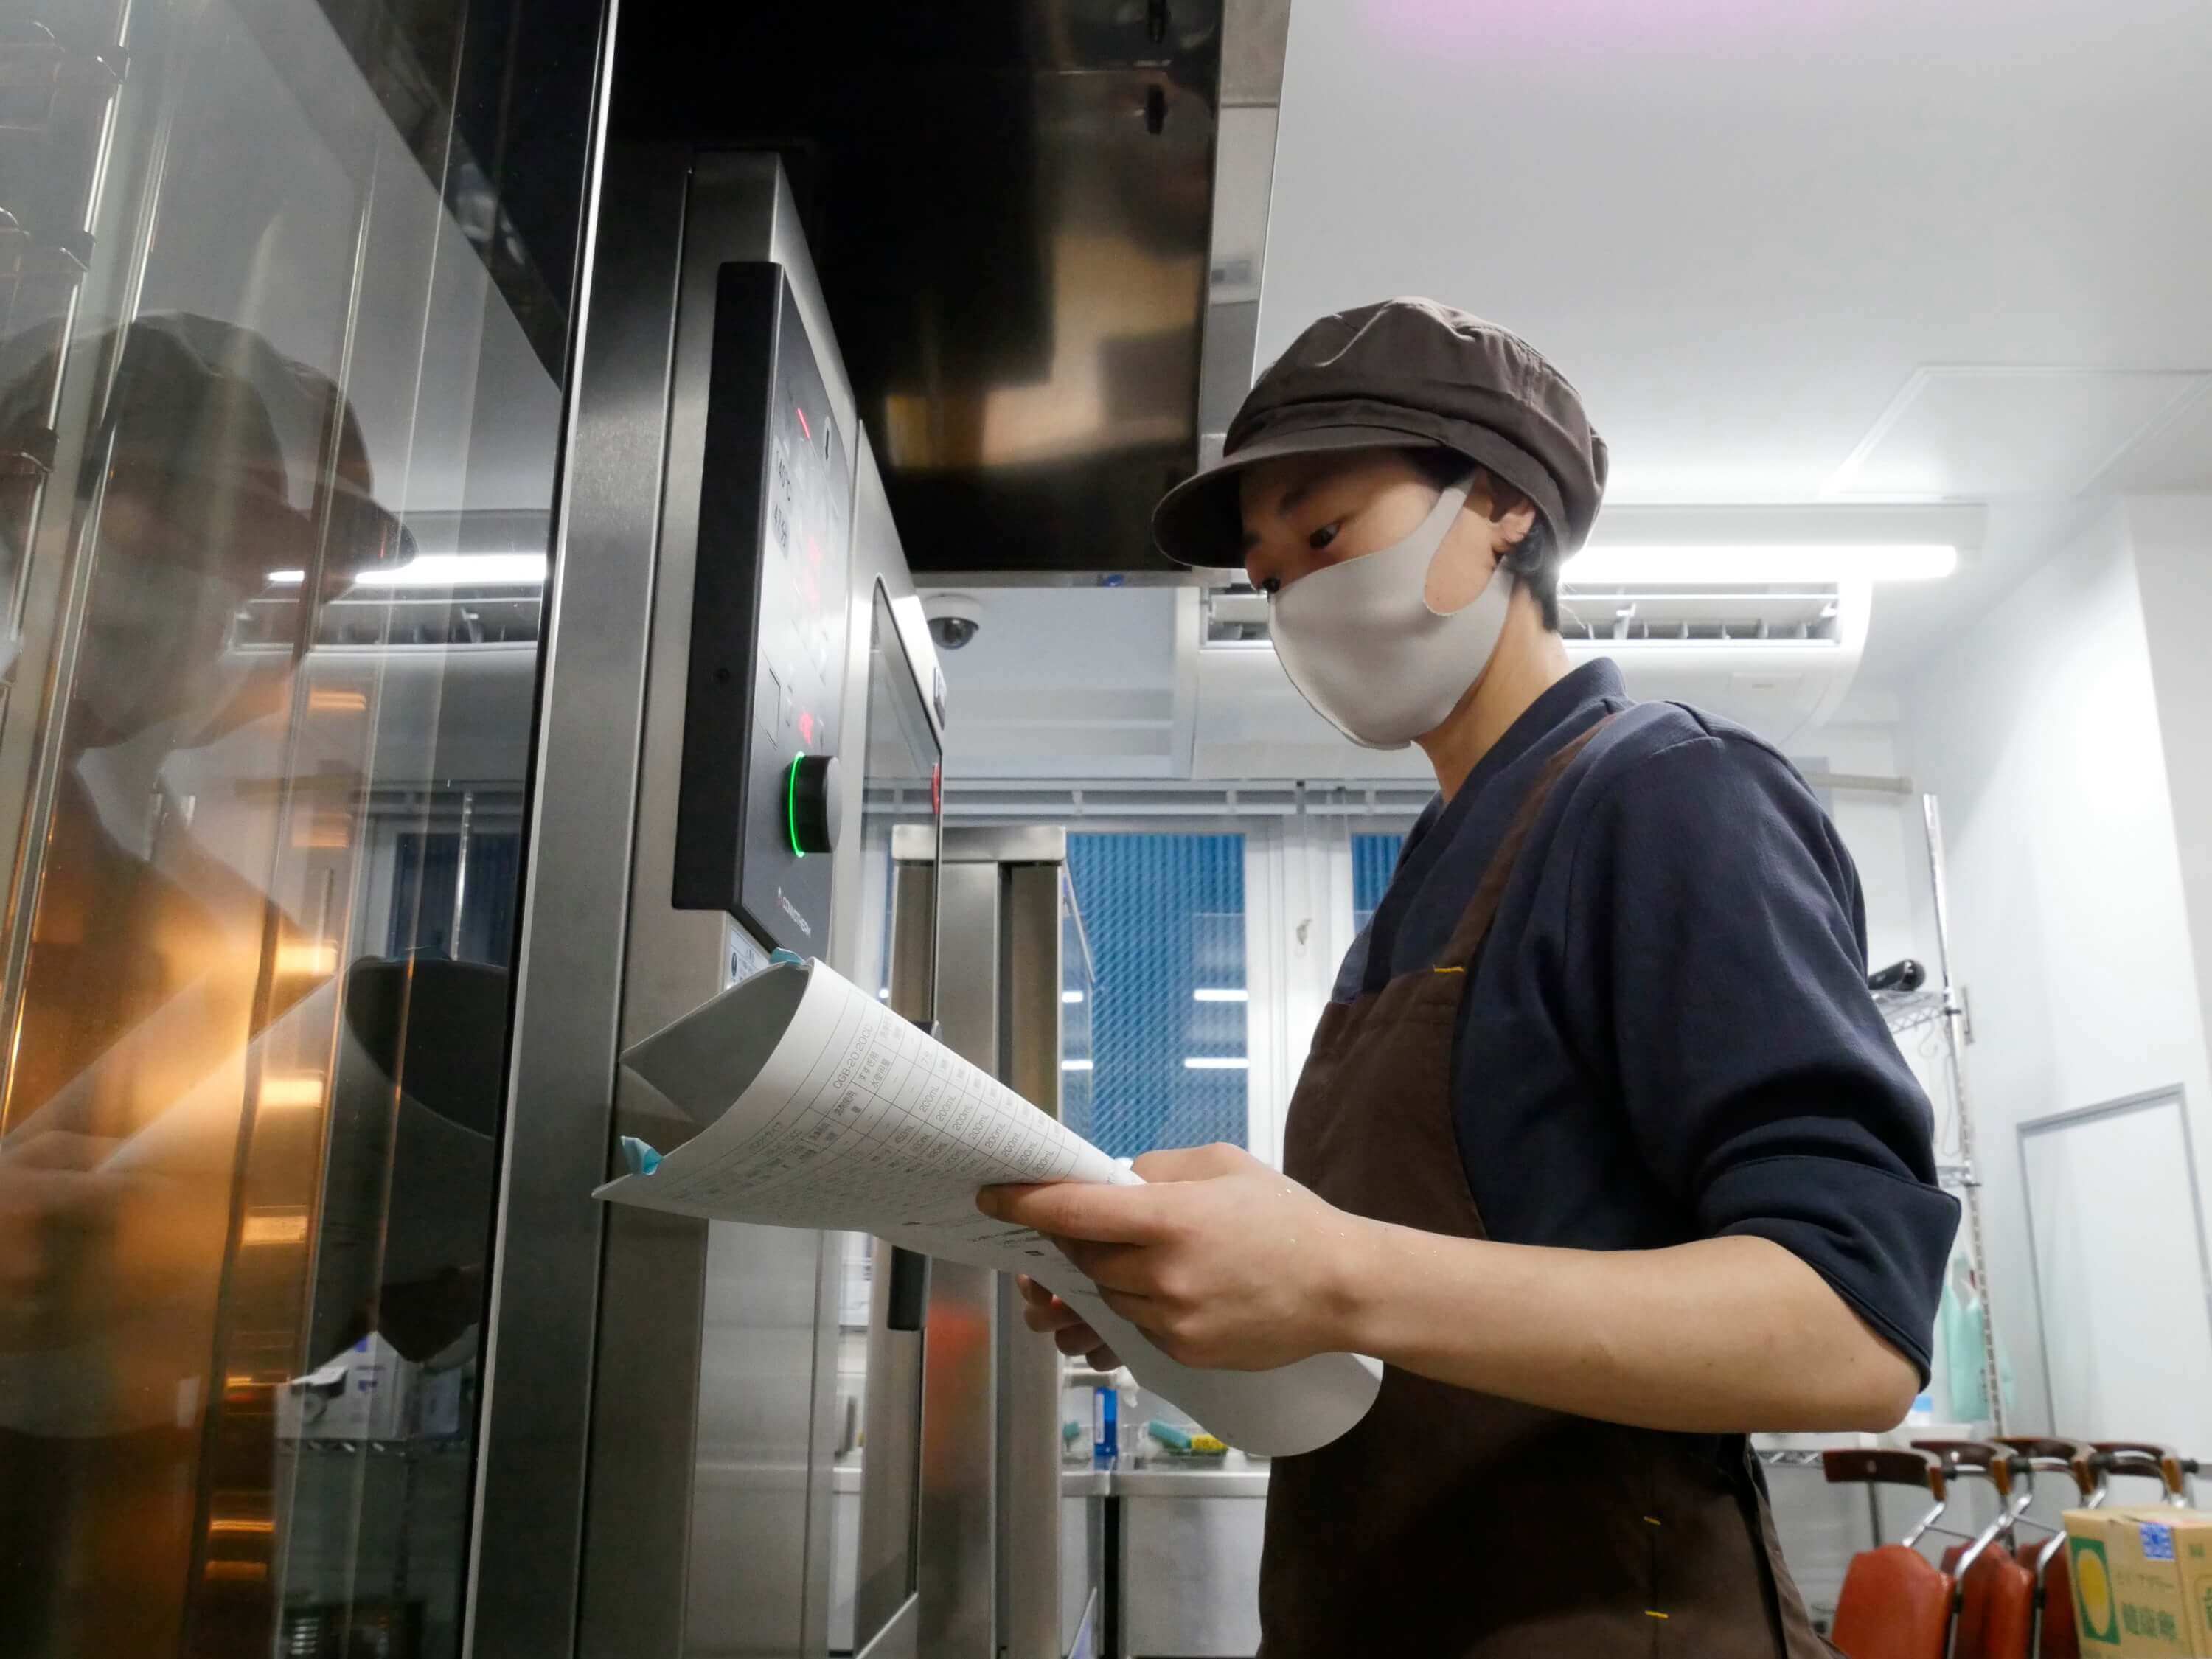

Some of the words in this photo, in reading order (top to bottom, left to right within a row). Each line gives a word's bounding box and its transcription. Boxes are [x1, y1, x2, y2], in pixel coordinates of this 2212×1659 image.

[919, 1085, 939, 1113] 200mL
[936, 1096, 956, 1121] 200mL
[953, 1105, 973, 1131] 200mL
[968, 1114, 990, 1140] 200mL
[984, 1123, 1006, 1149] 200mL
[1001, 1132, 1022, 1157] 200mL
[1017, 1141, 1038, 1165] 200mL
